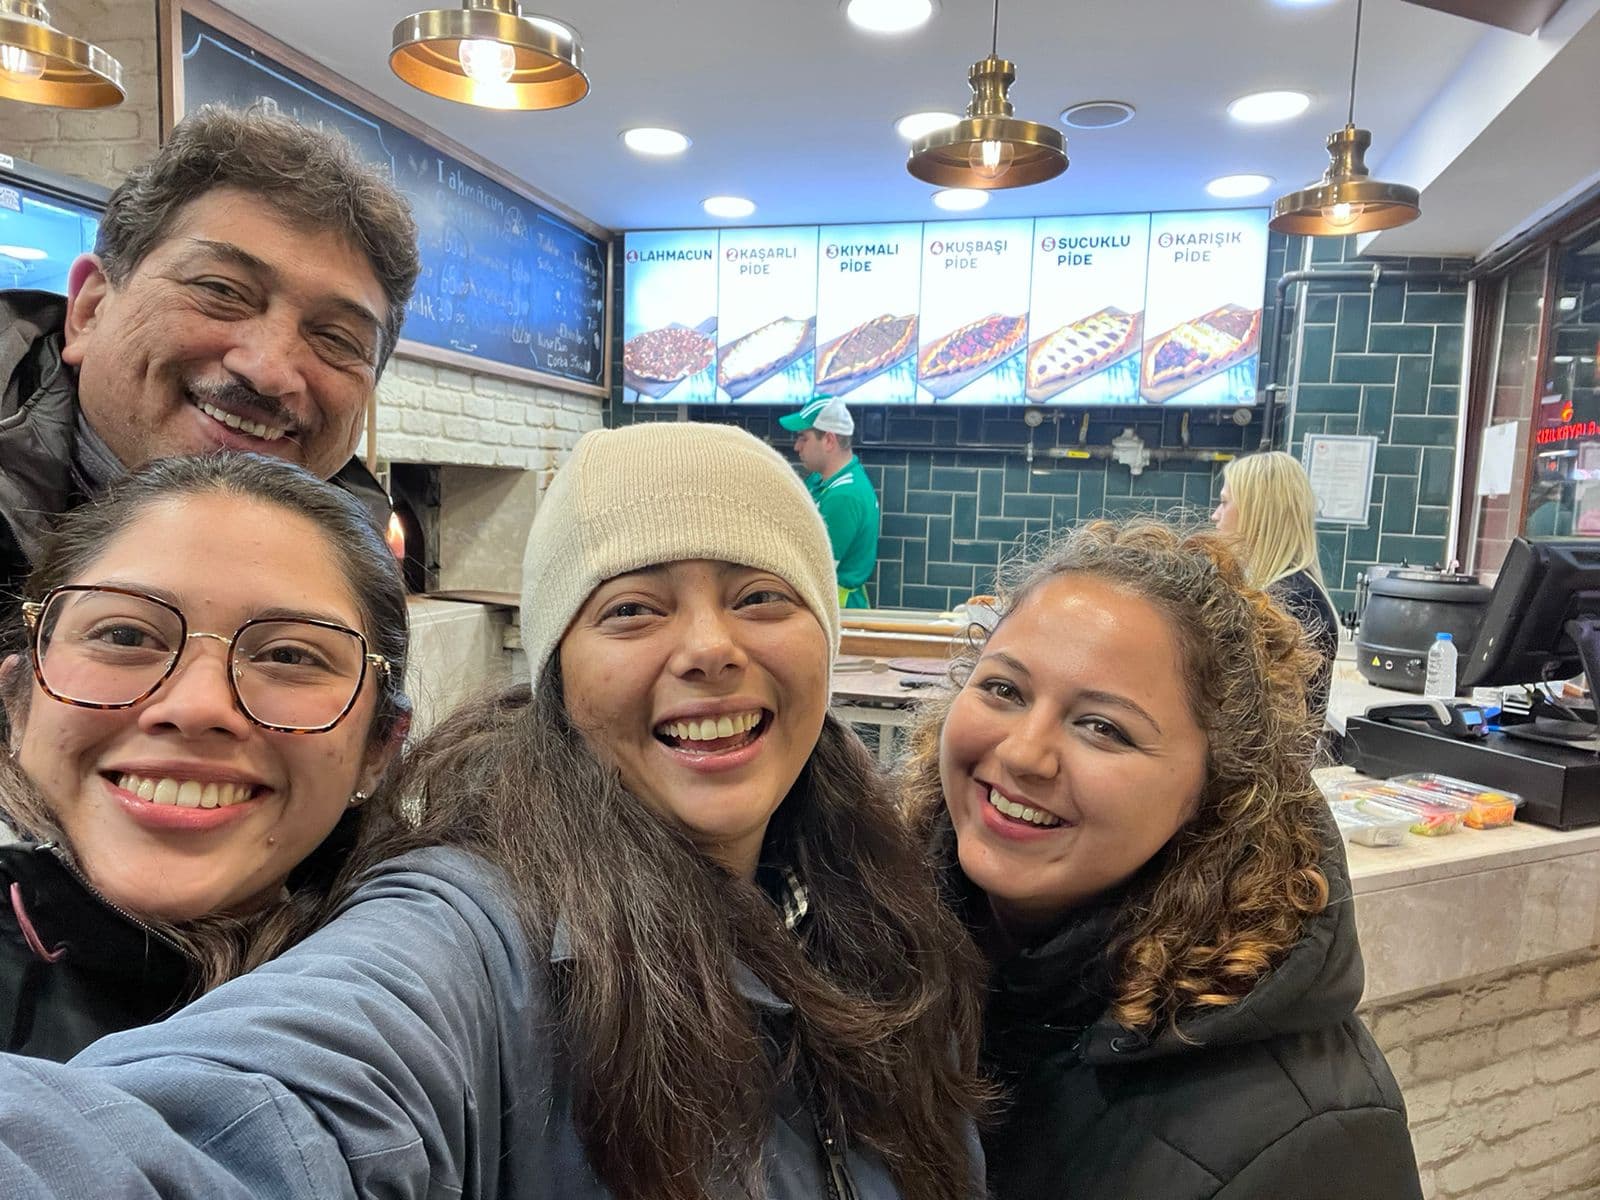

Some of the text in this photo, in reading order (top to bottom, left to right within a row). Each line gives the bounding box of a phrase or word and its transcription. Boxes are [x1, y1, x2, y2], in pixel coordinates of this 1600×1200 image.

[1058, 235, 1130, 249] SUCUKLU
[1175, 231, 1242, 248] KARIŞIK
[740, 247, 797, 262] KAŞARLI
[840, 244, 898, 256] KIYMALI
[945, 240, 1007, 255] KUŞBAŞI
[640, 249, 712, 261] LAHMACUN
[945, 255, 977, 269] PİDE
[1057, 251, 1093, 266] PİDE
[1174, 248, 1211, 263] PİDE
[740, 262, 770, 275] PİDE
[840, 259, 872, 272] PİDE
